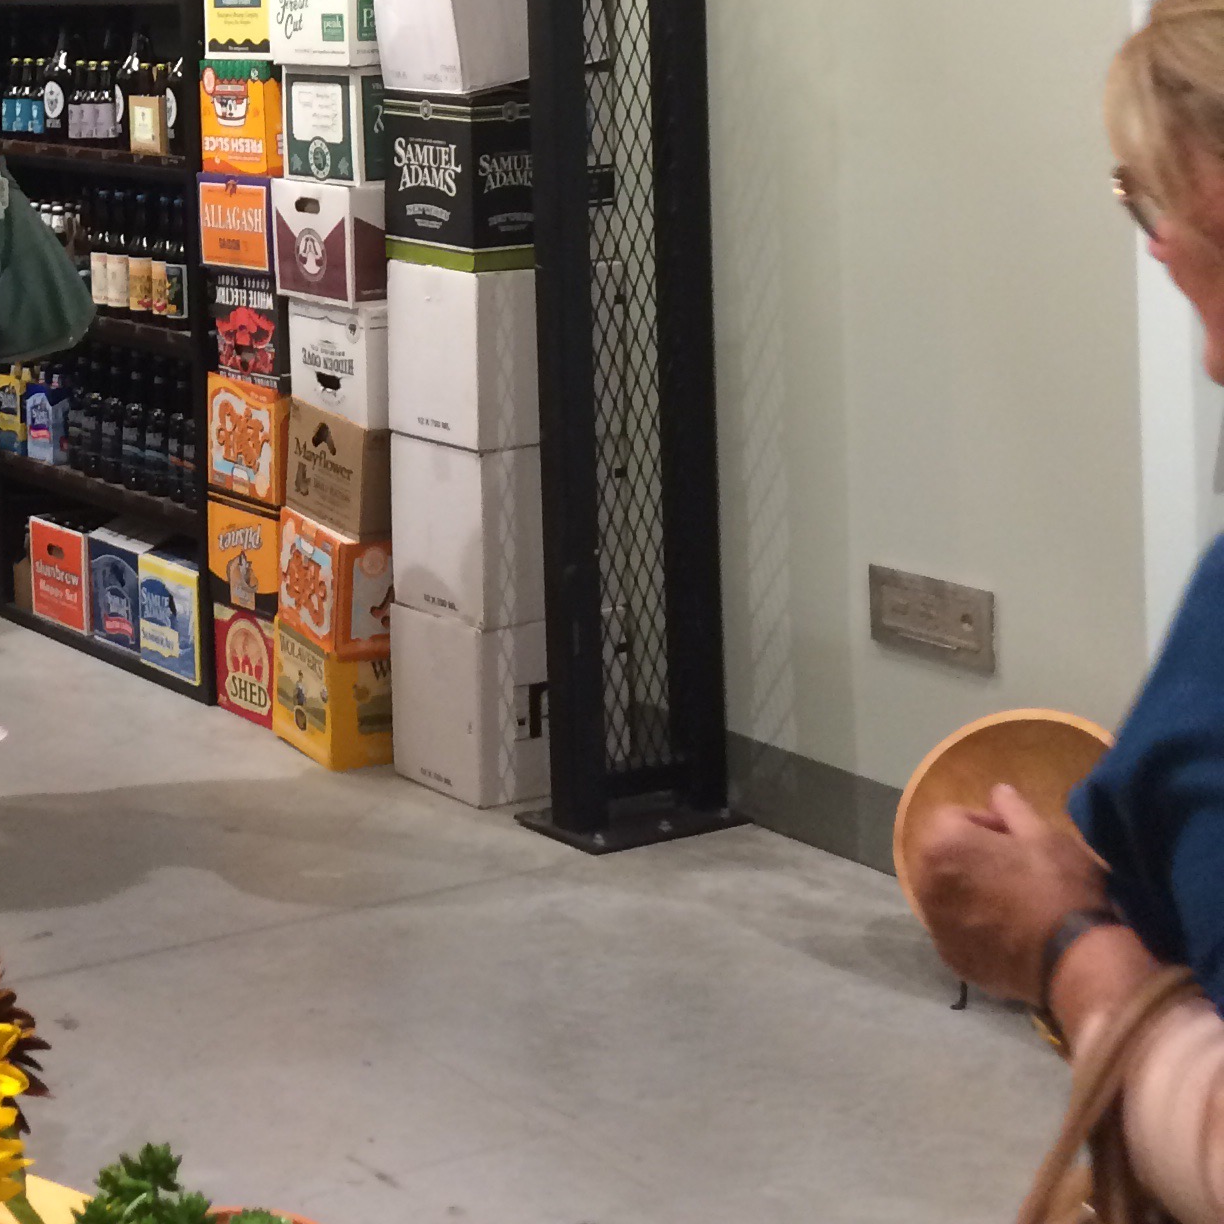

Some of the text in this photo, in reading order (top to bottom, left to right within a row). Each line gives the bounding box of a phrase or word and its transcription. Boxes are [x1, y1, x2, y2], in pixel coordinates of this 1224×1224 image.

[284, 12, 303, 39] Cut
[203, 136, 264, 154] FRESH SLICE
[393, 137, 462, 173] SAMUEL
[478, 154, 534, 177] SAMUE
[398, 164, 457, 197] ADAMS
[203, 202, 263, 233] ALLAGASH
[248, 290, 274, 310] WHITE
[301, 347, 355, 376] HIDDEN COVE
[294, 436, 354, 482] Mayflower
[218, 524, 263, 552] Pilsner
[230, 675, 268, 709] SHED
